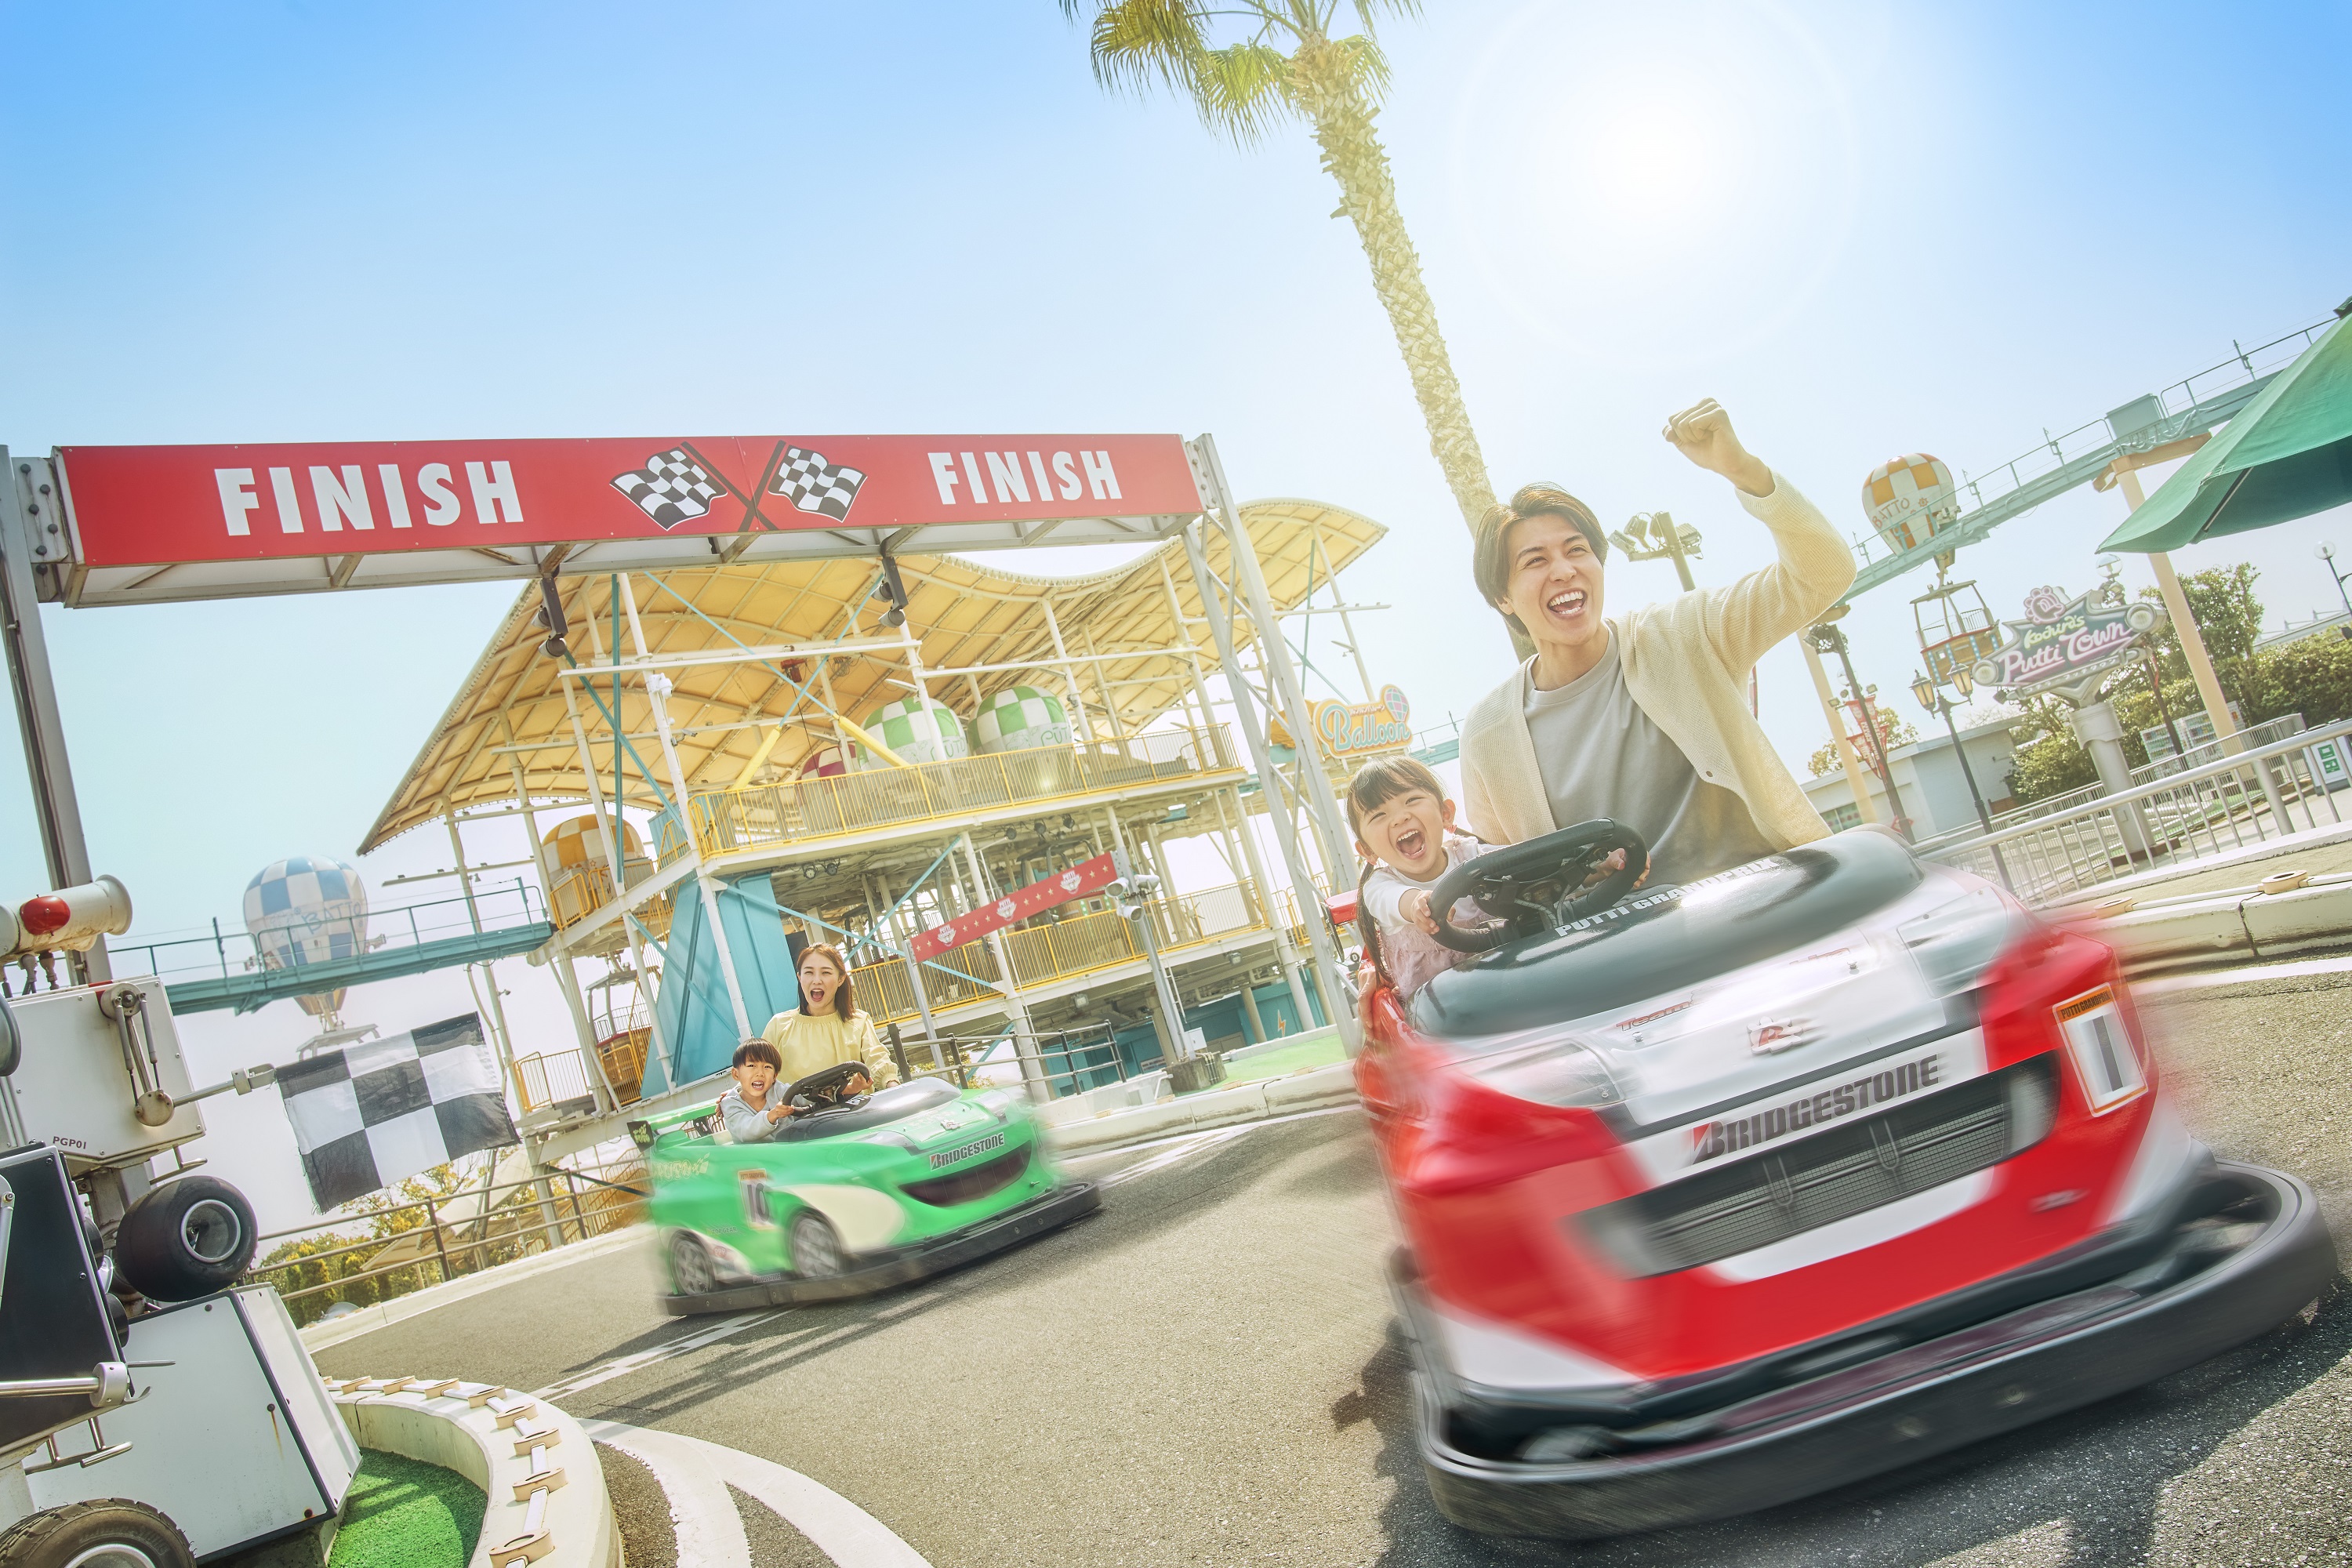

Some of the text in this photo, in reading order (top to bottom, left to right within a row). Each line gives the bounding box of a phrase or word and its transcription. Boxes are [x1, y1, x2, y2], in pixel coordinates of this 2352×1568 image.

[927, 449, 1123, 505] FINISH
[214, 460, 524, 537] FINISH
[1871, 497, 1911, 530] BATTO
[1998, 622, 2134, 685] Putti Town
[1320, 703, 1410, 751] Balloon
[301, 902, 361, 935] BATTO
[1555, 906, 1631, 938] PUTTI
[2060, 1003, 2081, 1019] PUTTI
[1693, 1054, 1940, 1165] BRIDGESTONE
[930, 1132, 1004, 1171] BRIDGESTONE
[747, 1182, 770, 1223] 10
